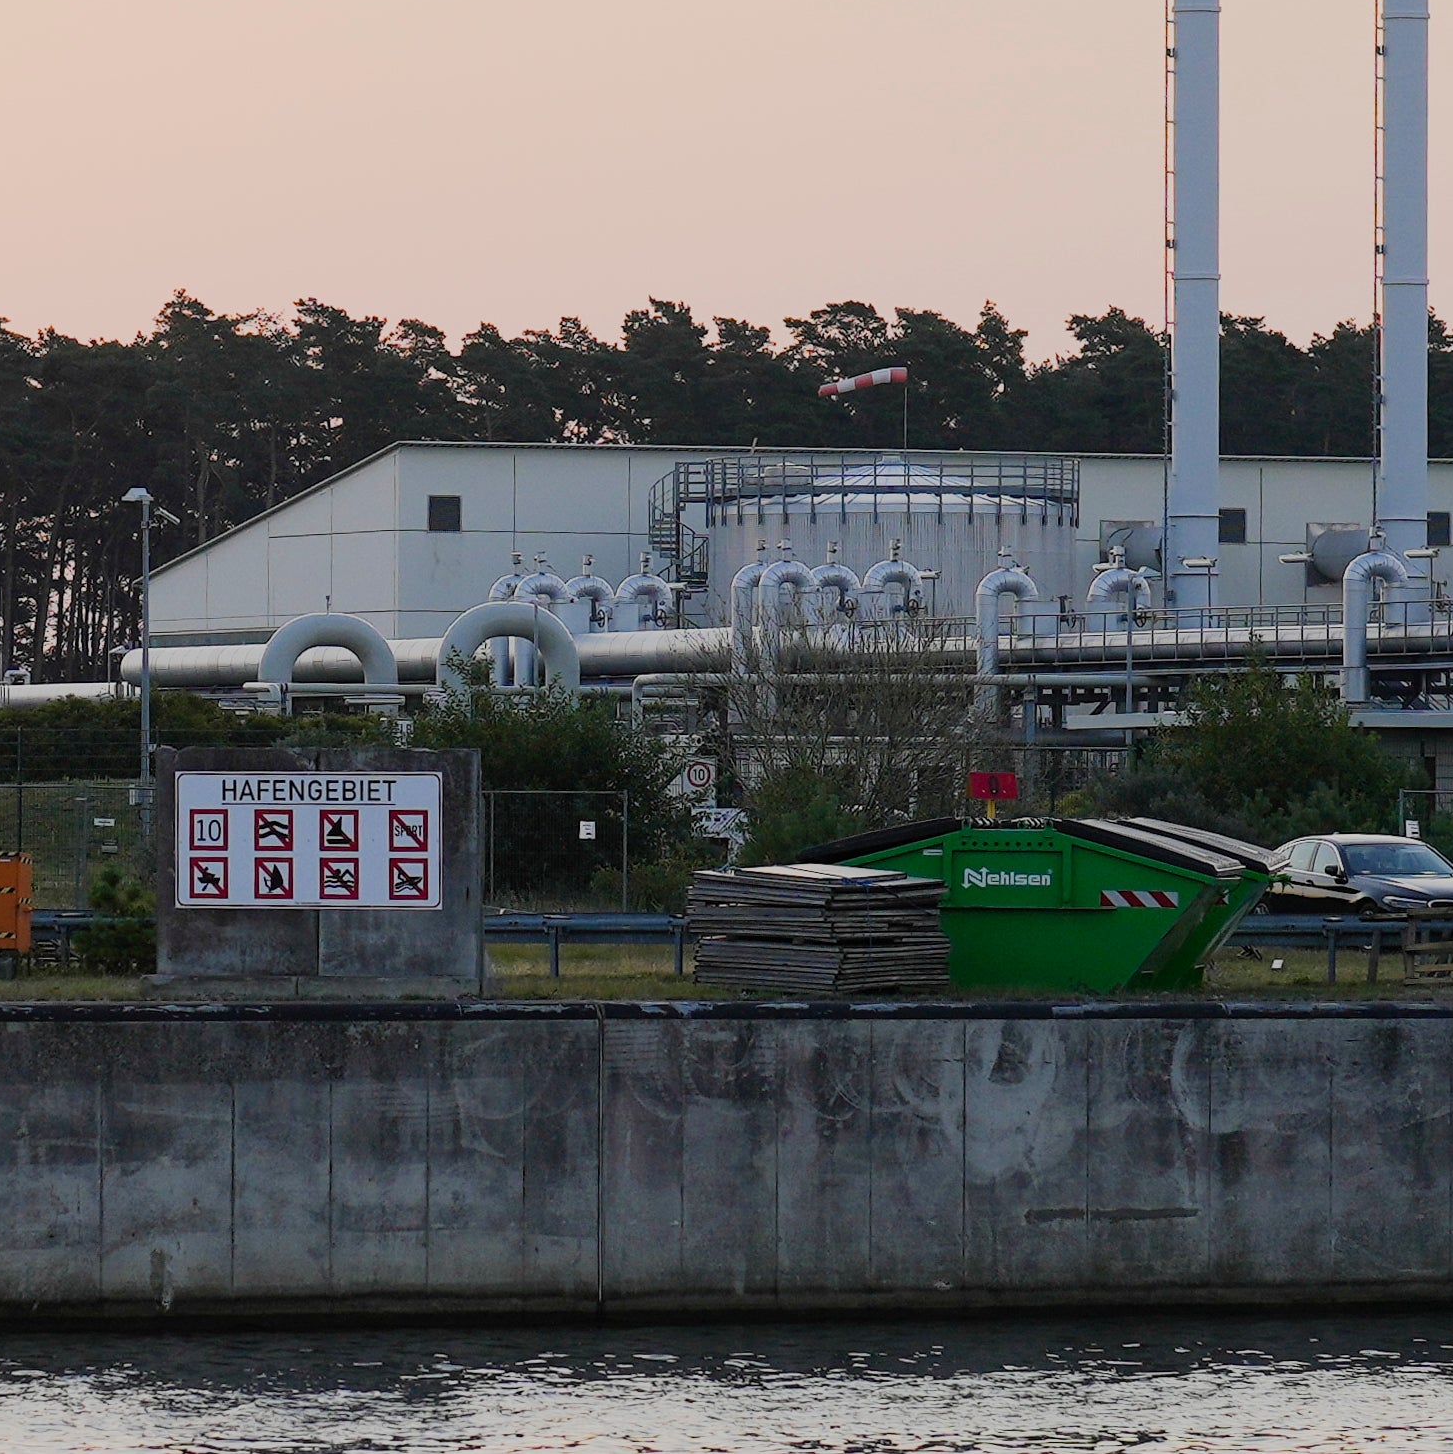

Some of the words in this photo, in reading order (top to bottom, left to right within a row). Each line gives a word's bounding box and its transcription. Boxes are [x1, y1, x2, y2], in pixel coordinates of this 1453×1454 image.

[693, 769, 706, 781] 10
[222, 779, 397, 802] HAFENGEBIET
[197, 819, 222, 842] 10
[395, 825, 423, 837] SPORT
[961, 867, 1051, 889] Nehlsen
